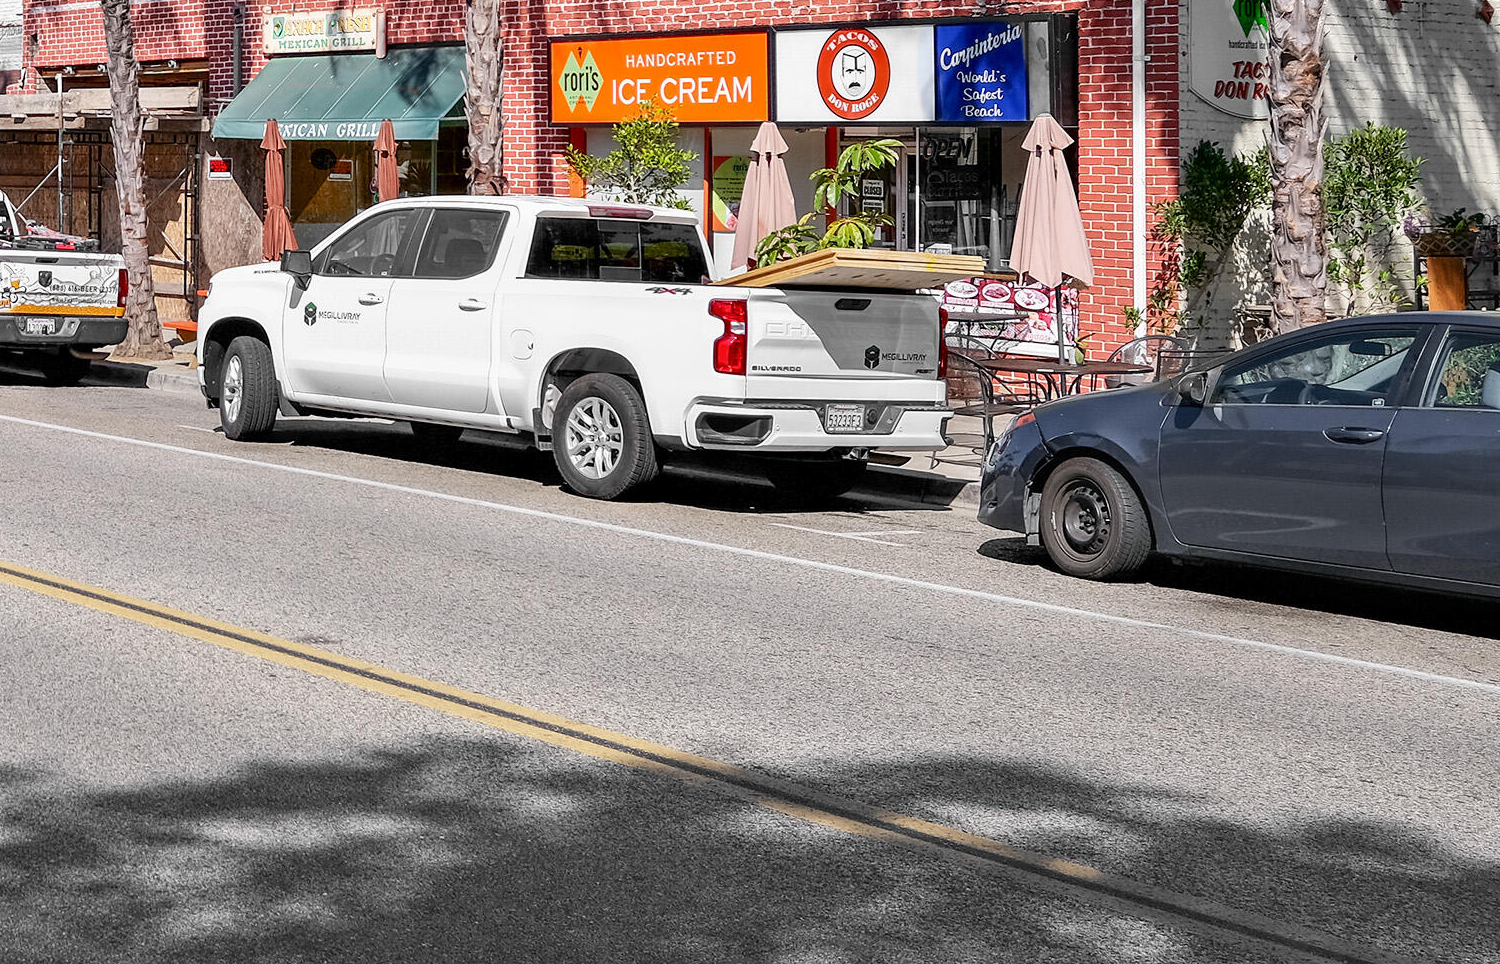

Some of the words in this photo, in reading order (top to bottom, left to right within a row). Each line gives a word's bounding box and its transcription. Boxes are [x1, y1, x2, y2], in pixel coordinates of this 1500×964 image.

[278, 39, 328, 50] MEXICAN
[332, 37, 366, 47] GRILL
[826, 31, 879, 53] TACOS
[940, 23, 1023, 71] Carpinteria
[626, 50, 737, 68] HANDCRAFTED
[564, 66, 599, 92] rori's
[956, 70, 1006, 84] World's
[612, 78, 651, 105] ICE
[659, 76, 752, 104] CREAM
[962, 87, 1004, 102] Safest
[1215, 81, 1250, 100] DON
[827, 92, 850, 113] DON
[850, 92, 880, 113] ROGE
[961, 104, 1003, 117] Beach
[336, 123, 380, 137] GRILL
[923, 136, 975, 161] OPEN
[944, 170, 979, 183] Tacos
[864, 186, 882, 195] CLOSED
[828, 414, 861, 427] 53233F3
